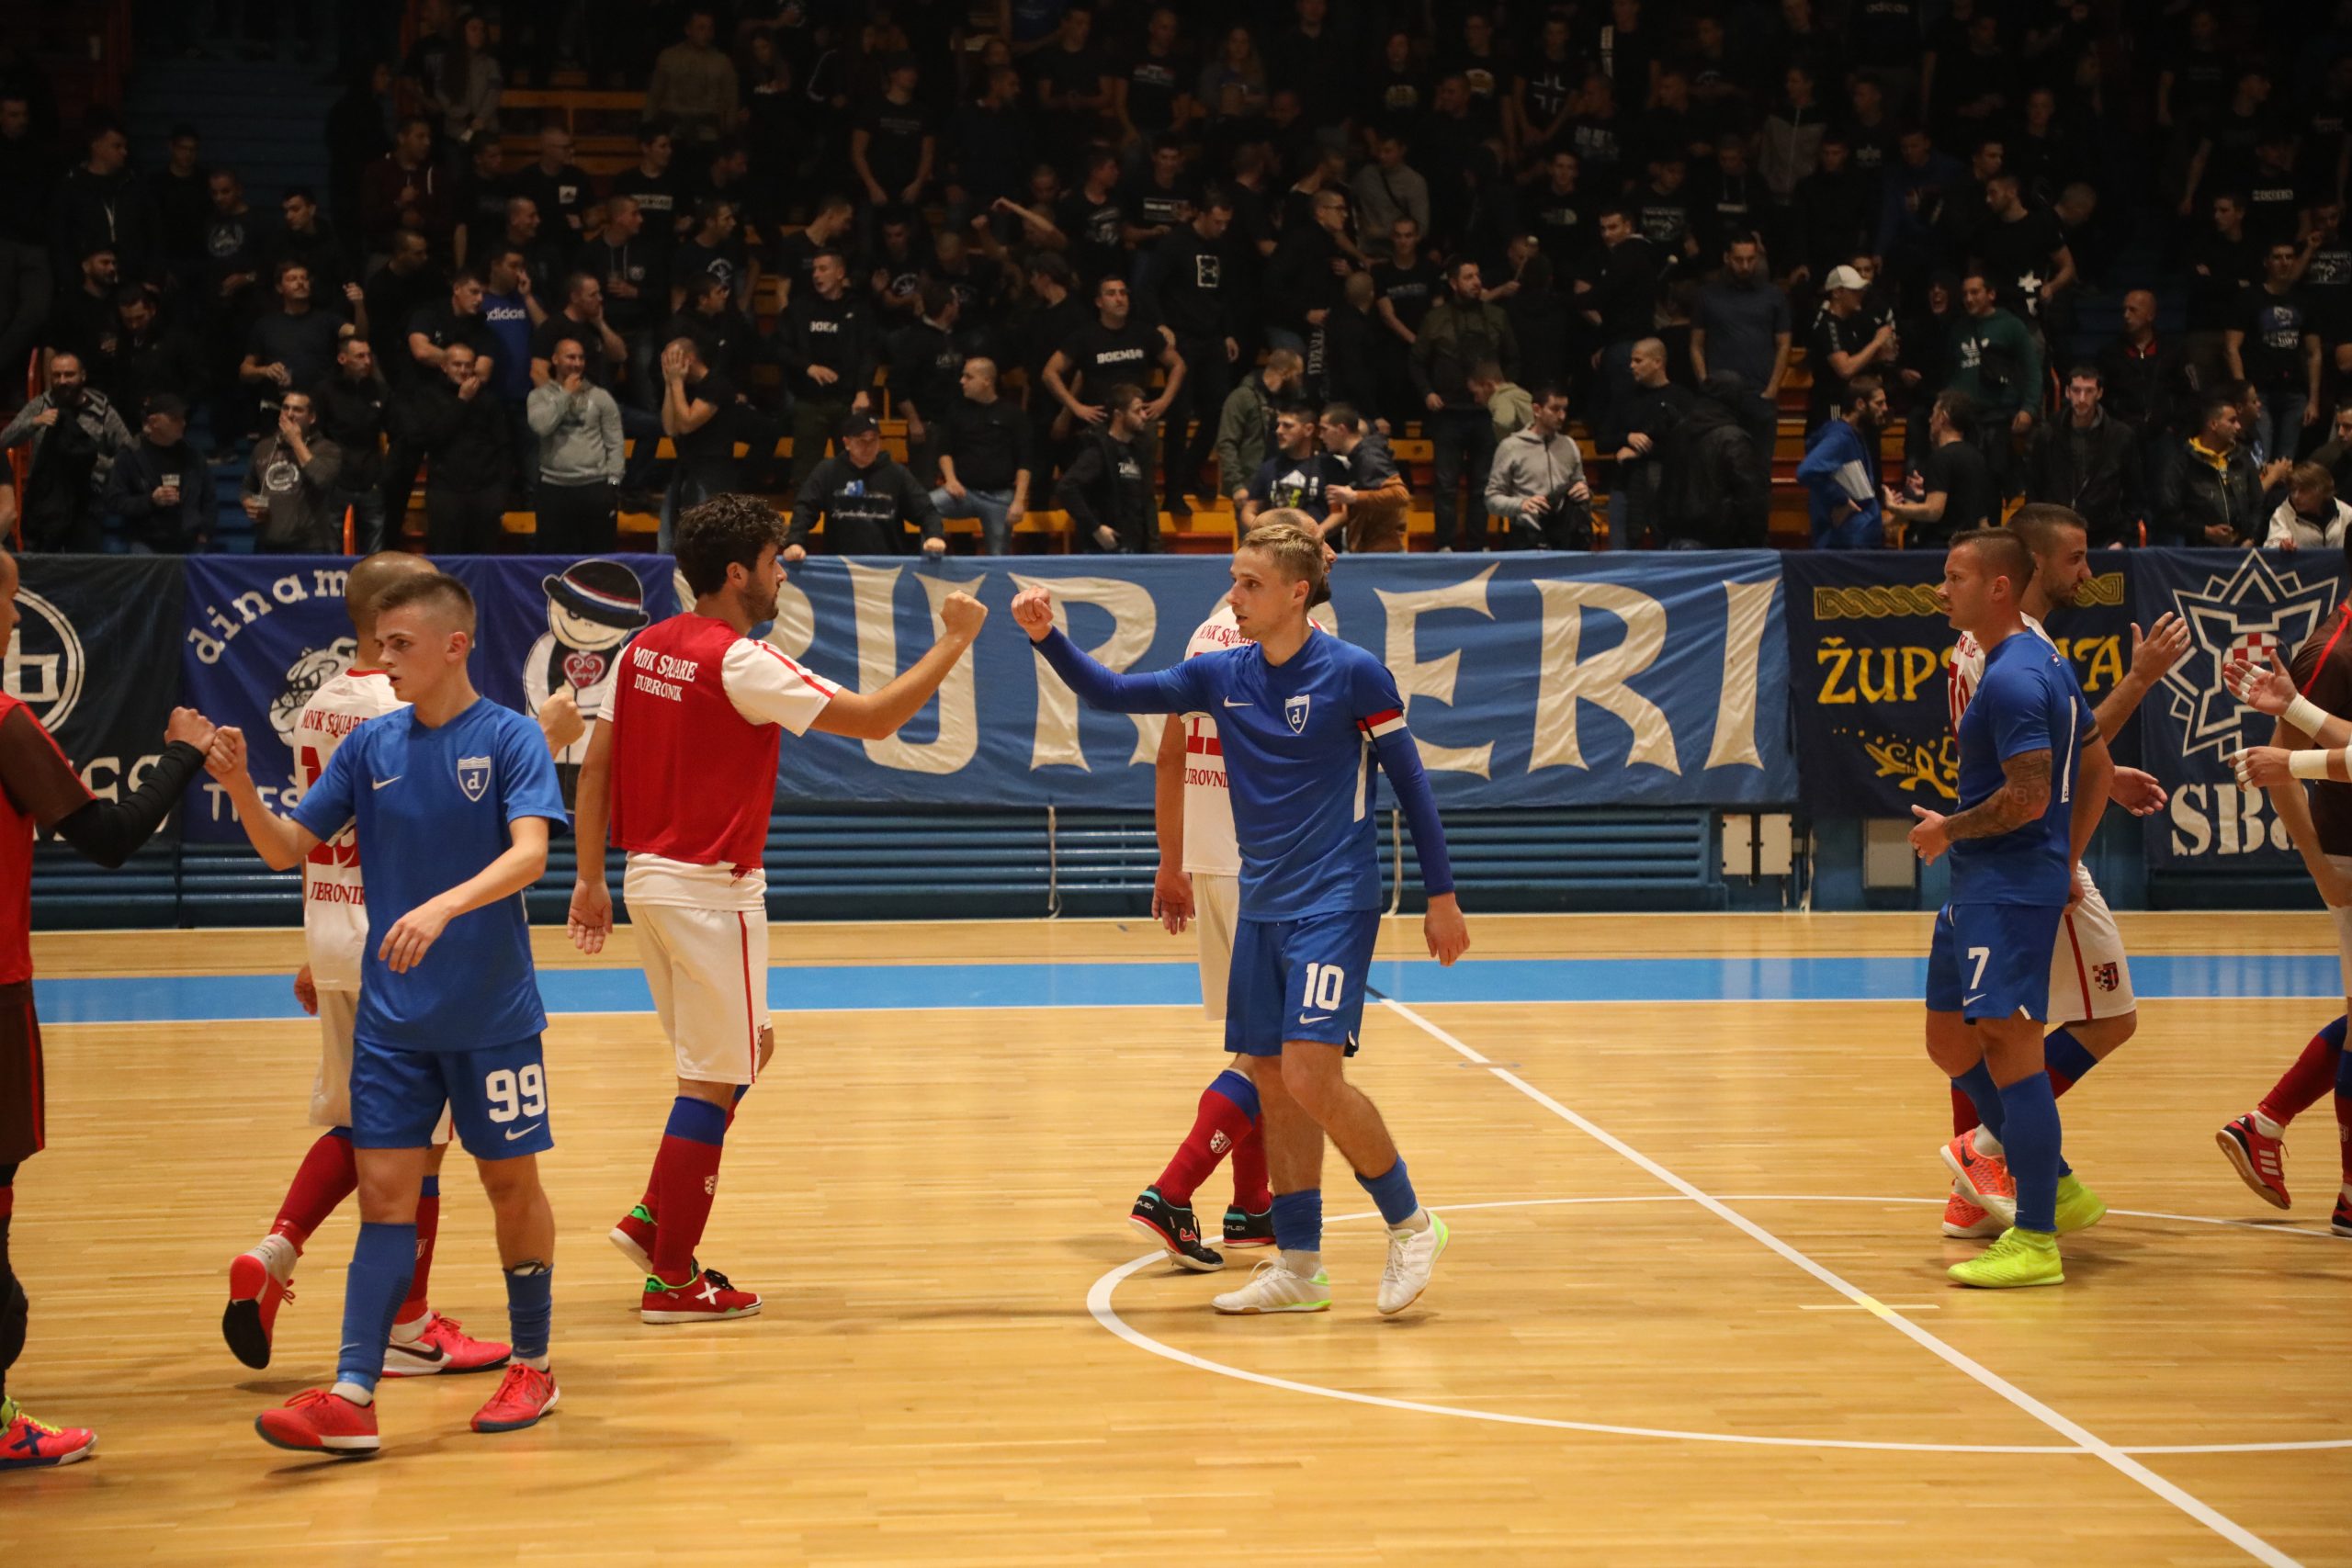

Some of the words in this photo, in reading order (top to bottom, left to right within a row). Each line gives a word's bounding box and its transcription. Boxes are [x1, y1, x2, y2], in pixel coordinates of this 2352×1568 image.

[187, 570, 350, 664] dinam
[674, 554, 1781, 781] URERI
[325, 713, 370, 738] SQUAR
[1291, 707, 1302, 724] d
[467, 771, 481, 790] d
[1302, 962, 1345, 1011] 10
[1967, 946, 1991, 990] 7
[485, 1063, 548, 1123] 99
